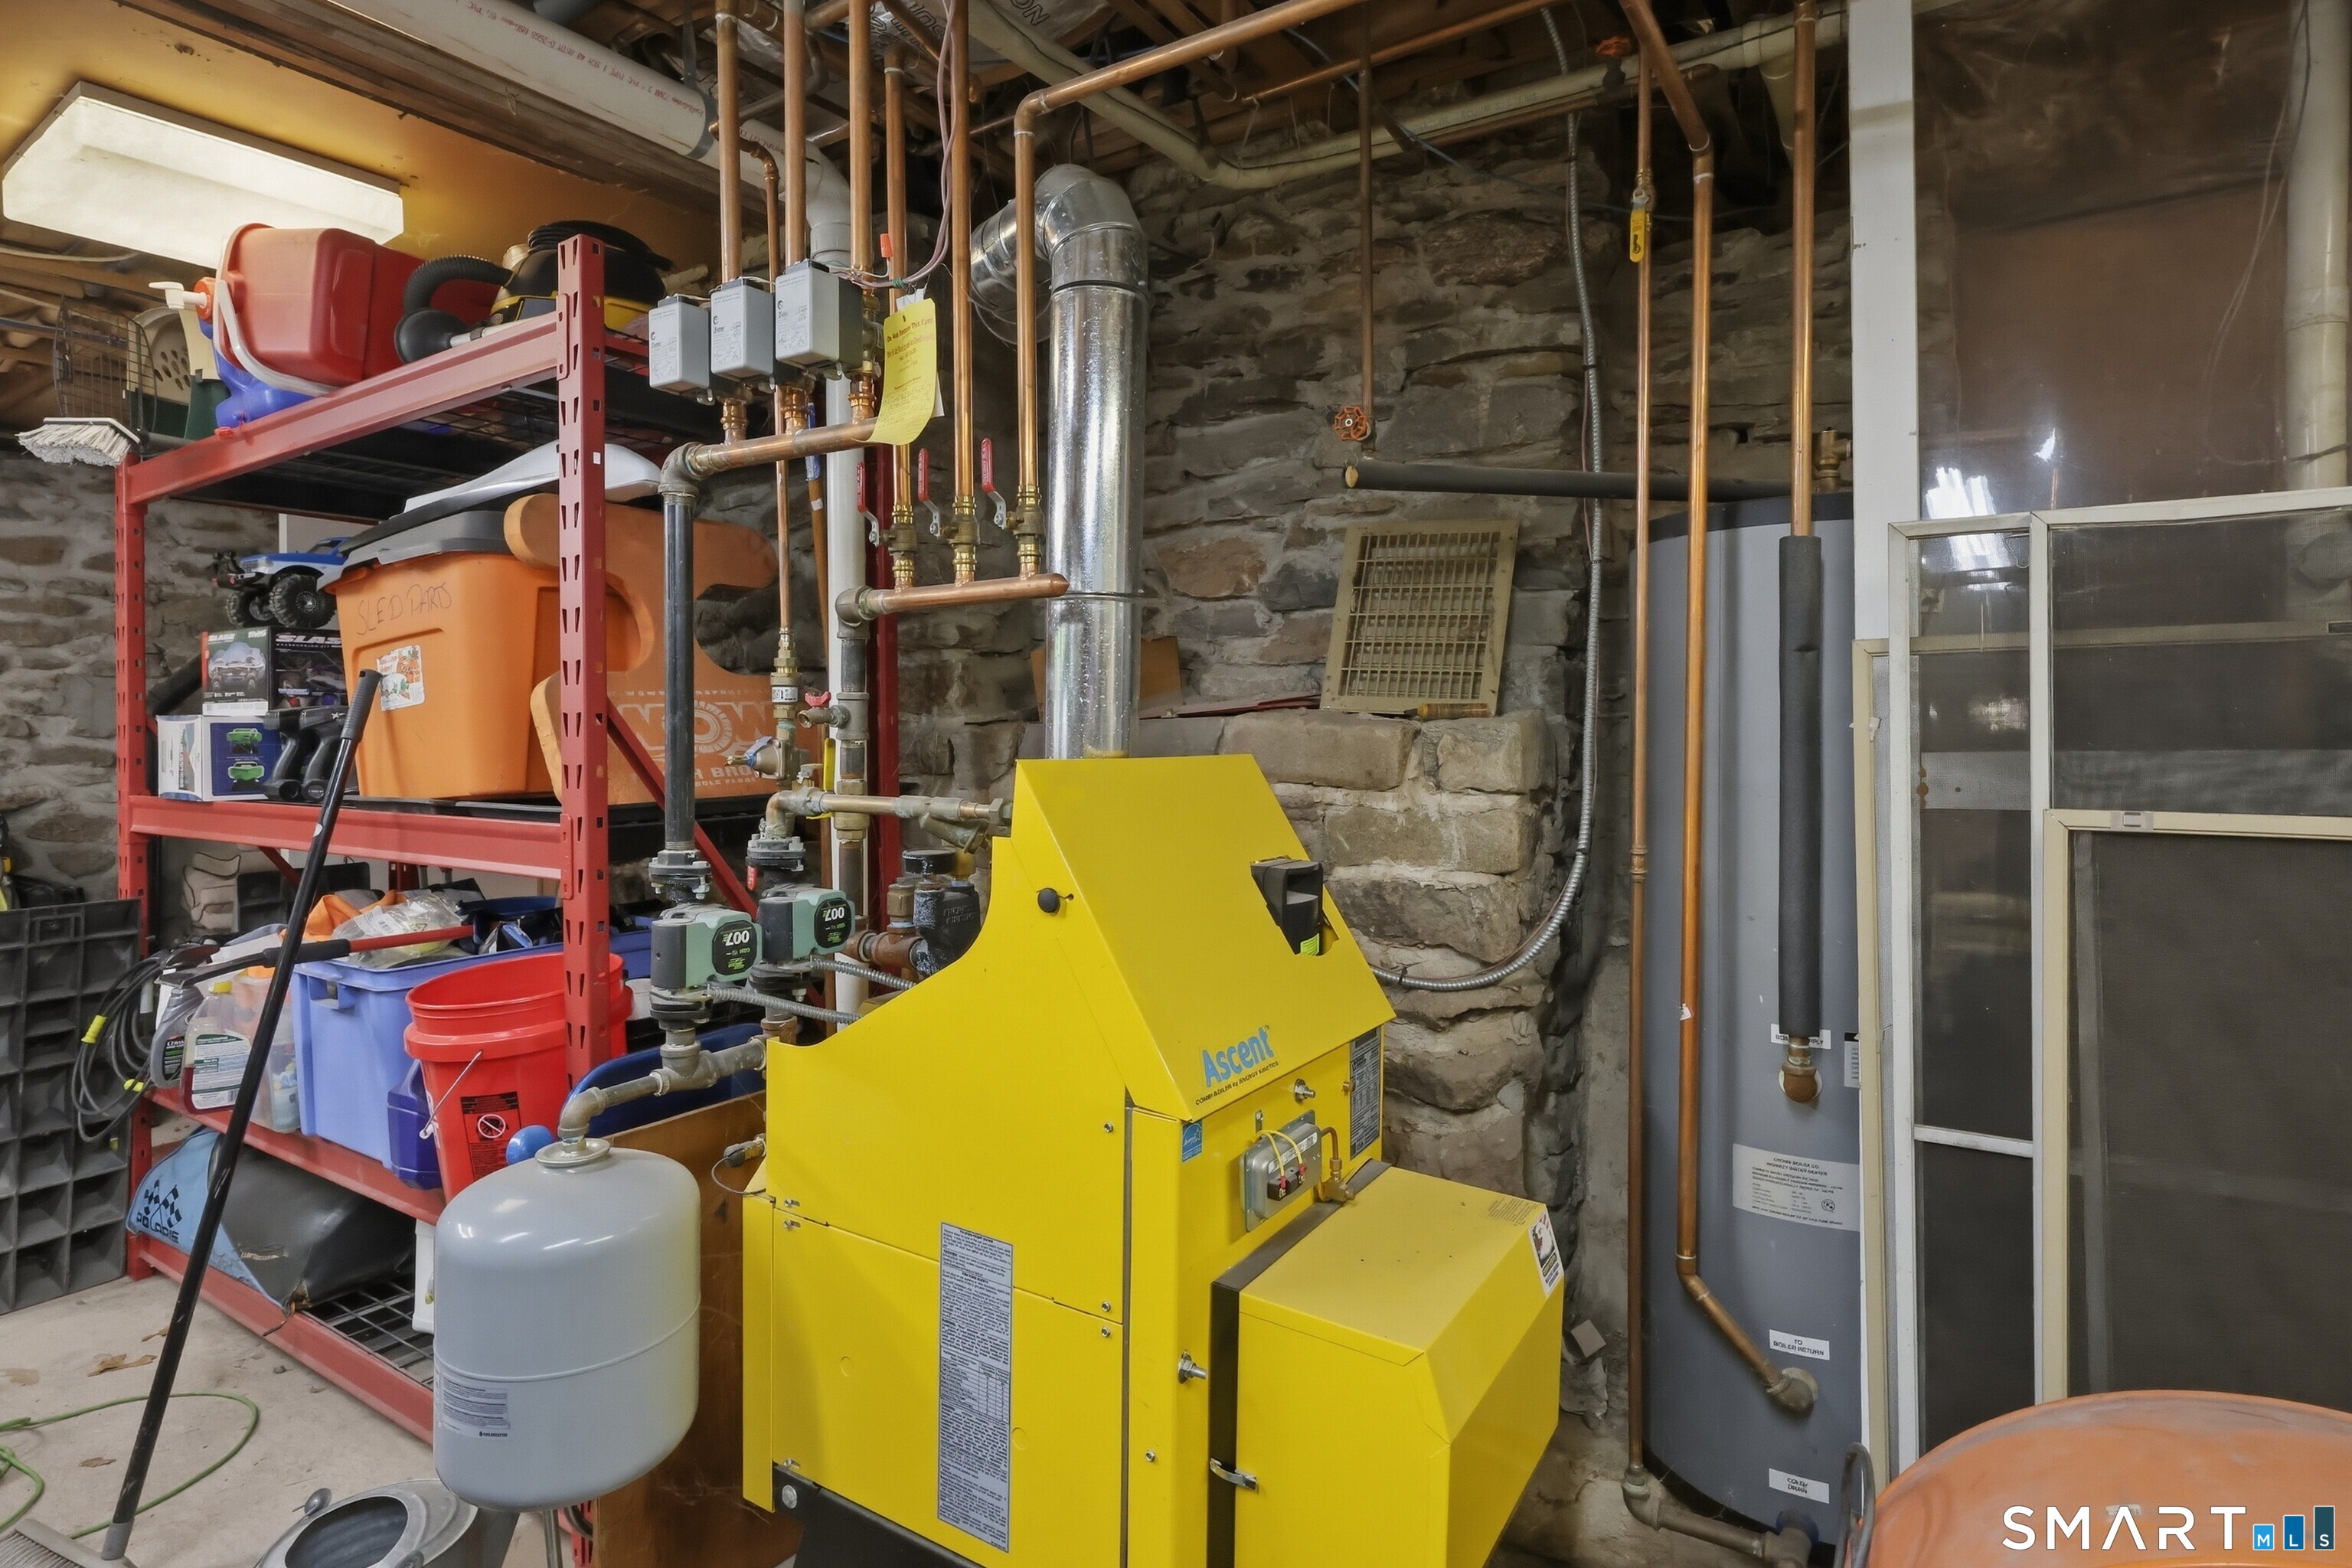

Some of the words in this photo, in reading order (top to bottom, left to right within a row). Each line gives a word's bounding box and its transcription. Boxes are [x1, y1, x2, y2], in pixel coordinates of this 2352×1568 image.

[356, 594, 403, 635] SLED
[407, 581, 452, 616] PARTS
[276, 635, 342, 645] SLAS
[824, 906, 845, 922] 007
[725, 929, 750, 947] 007
[1202, 1027, 1275, 1088] Ascent
[136, 1211, 180, 1244] POLARIS
